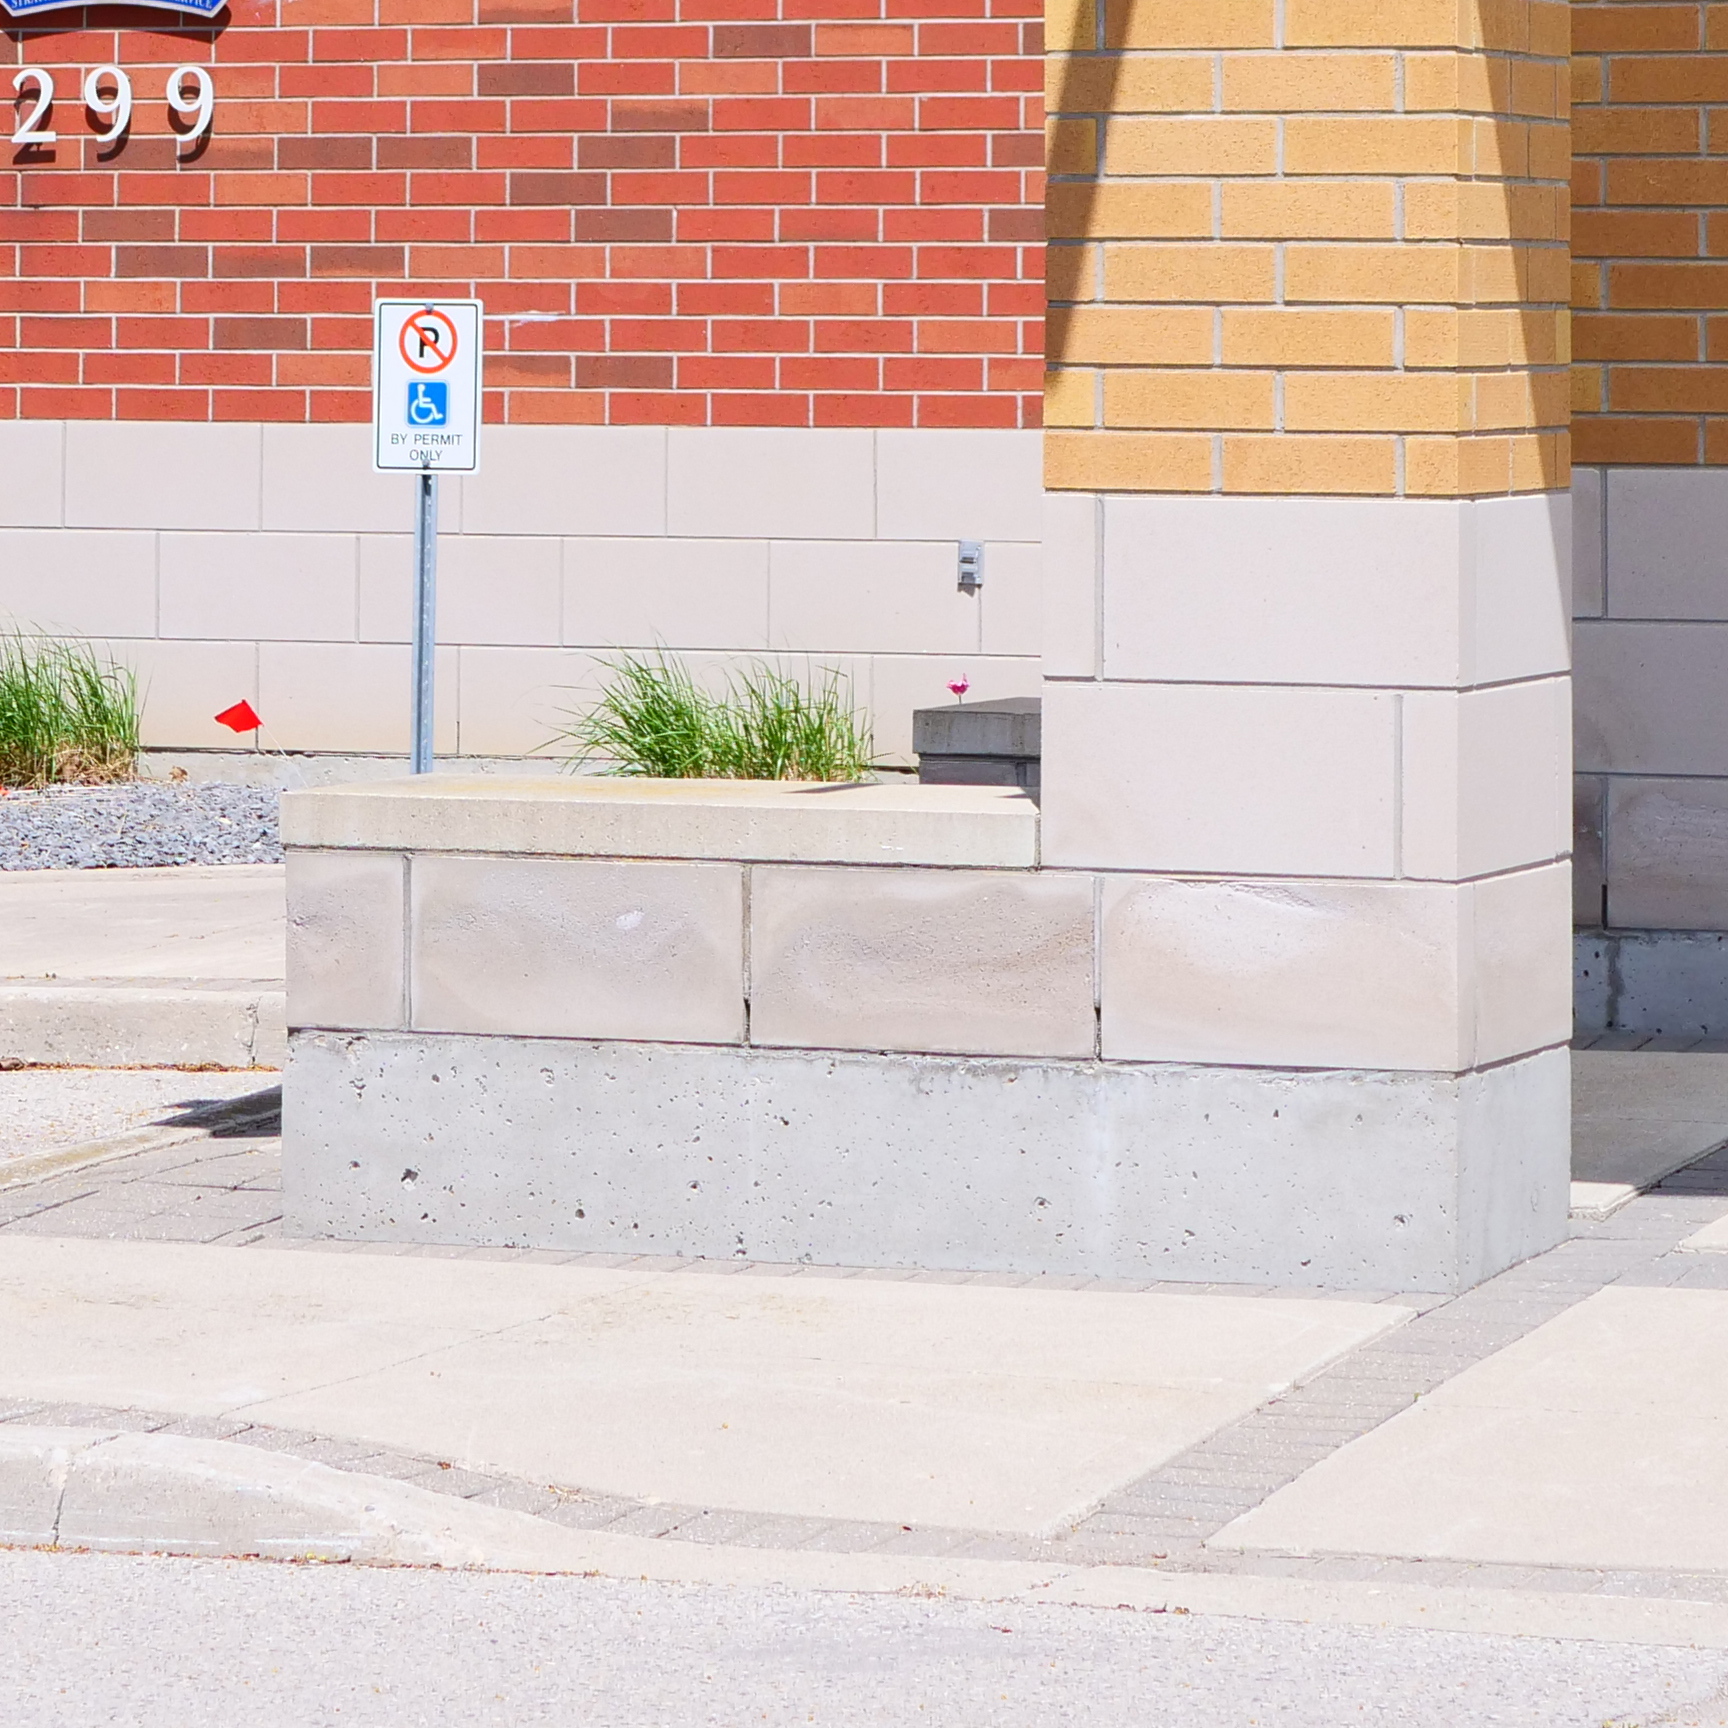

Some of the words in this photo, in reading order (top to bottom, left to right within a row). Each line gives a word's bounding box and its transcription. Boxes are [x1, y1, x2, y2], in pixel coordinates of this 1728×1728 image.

[10, 64, 215, 145] 299
[390, 433, 409, 446] BY
[413, 433, 463, 447] PERMIT
[409, 449, 443, 462] ONLY
